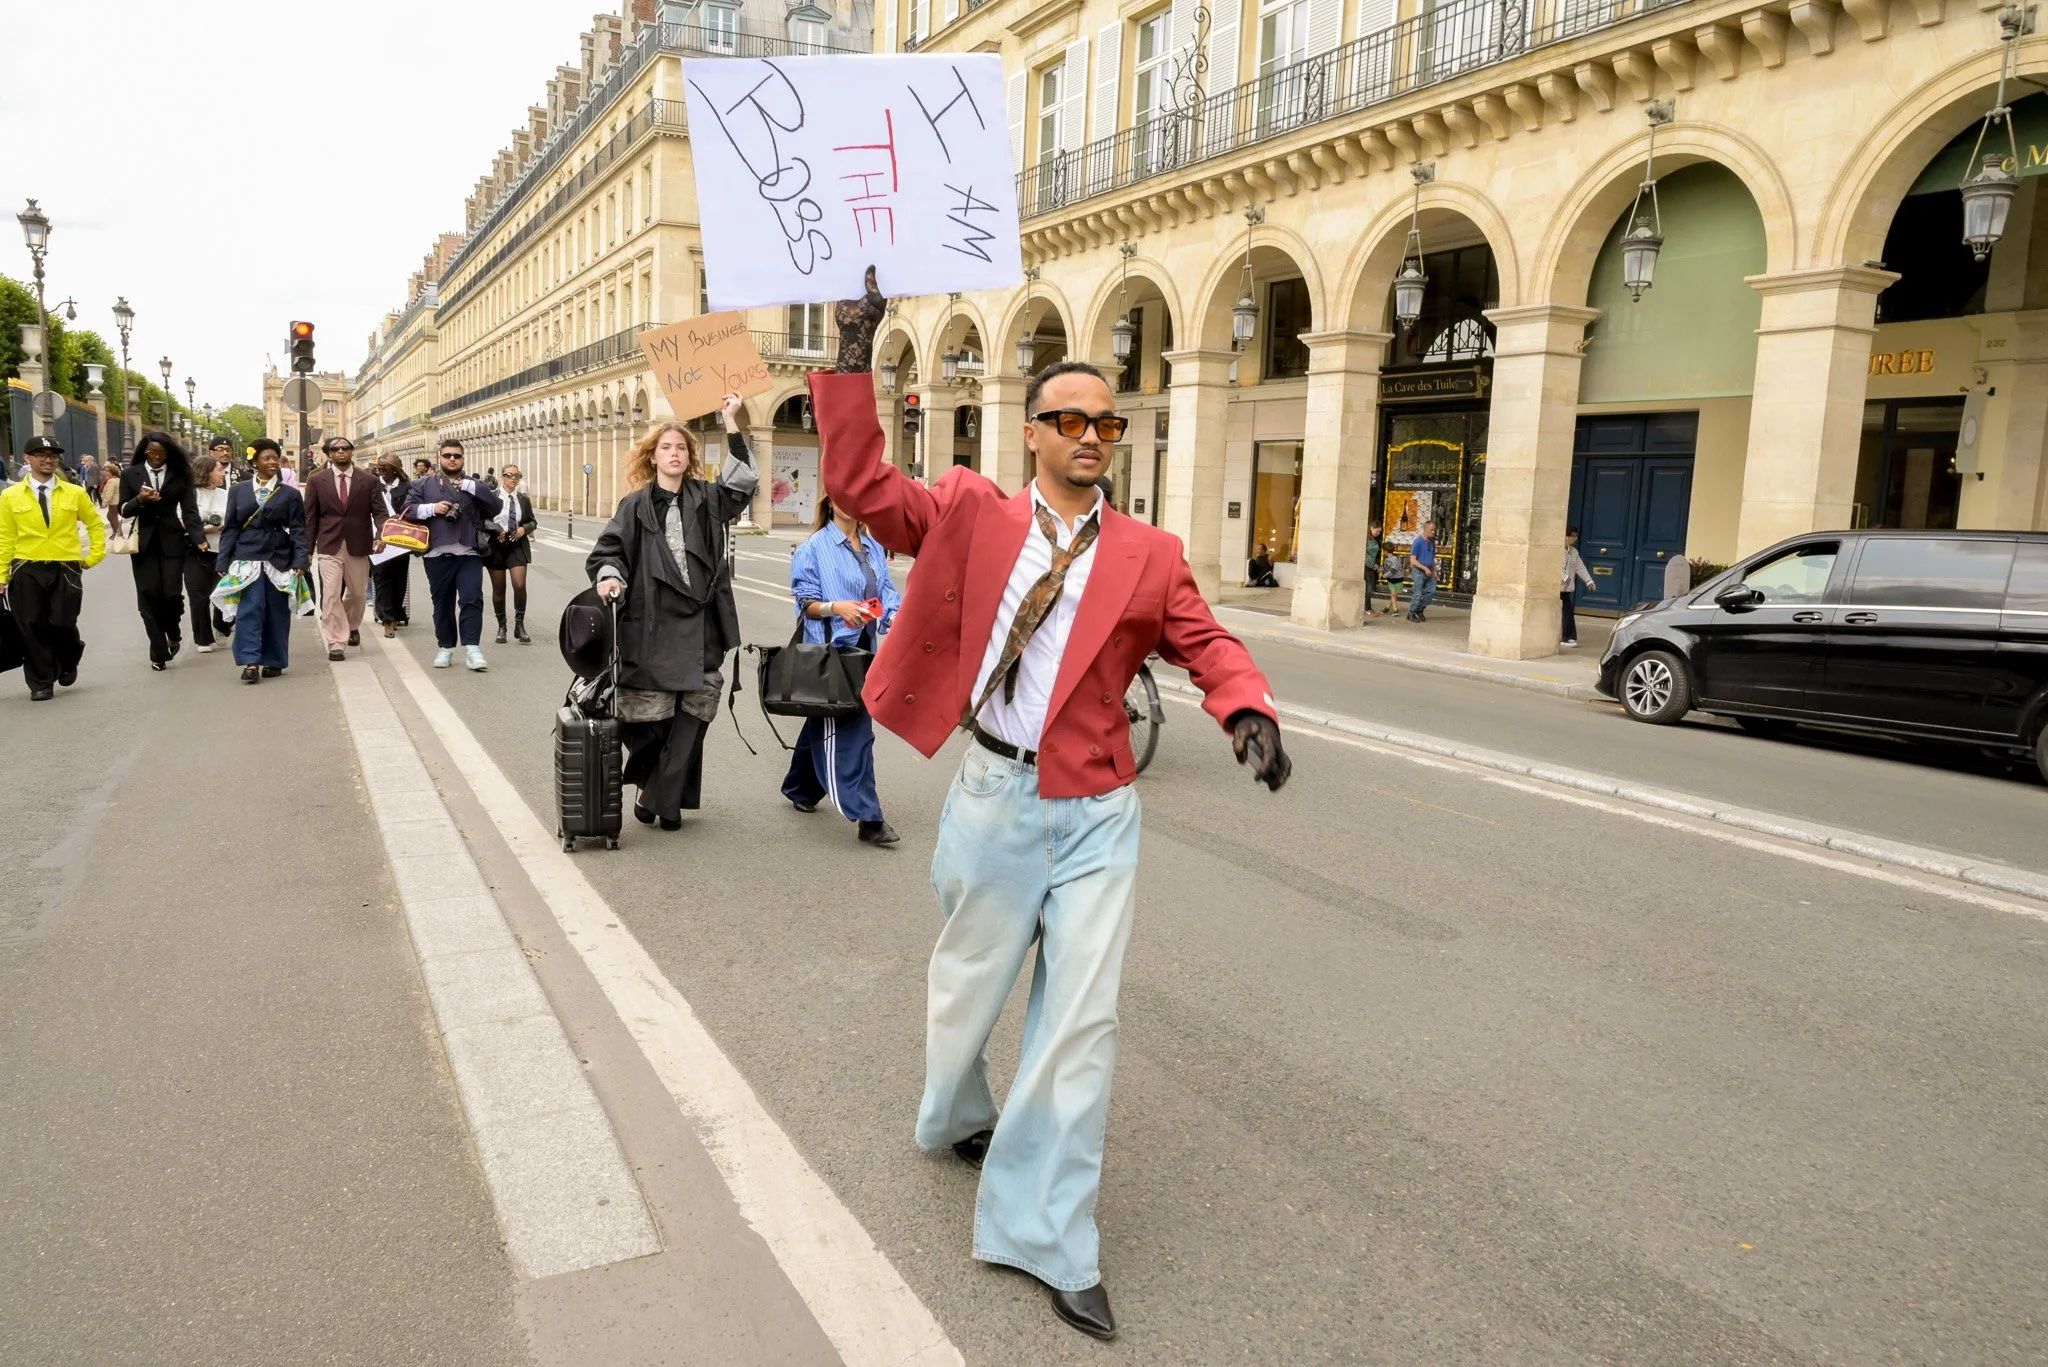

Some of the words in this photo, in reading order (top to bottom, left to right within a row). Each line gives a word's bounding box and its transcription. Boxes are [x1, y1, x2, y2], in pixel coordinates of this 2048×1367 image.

[907, 65, 986, 164] I
[688, 59, 833, 276] BOSS
[832, 108, 898, 247] THE
[941, 183, 1000, 263] AM
[649, 334, 679, 362] MY
[1986, 339, 2007, 348] 232
[1382, 383, 1393, 394] La
[1394, 381, 1416, 392] Cave
[1417, 380, 1433, 392] des
